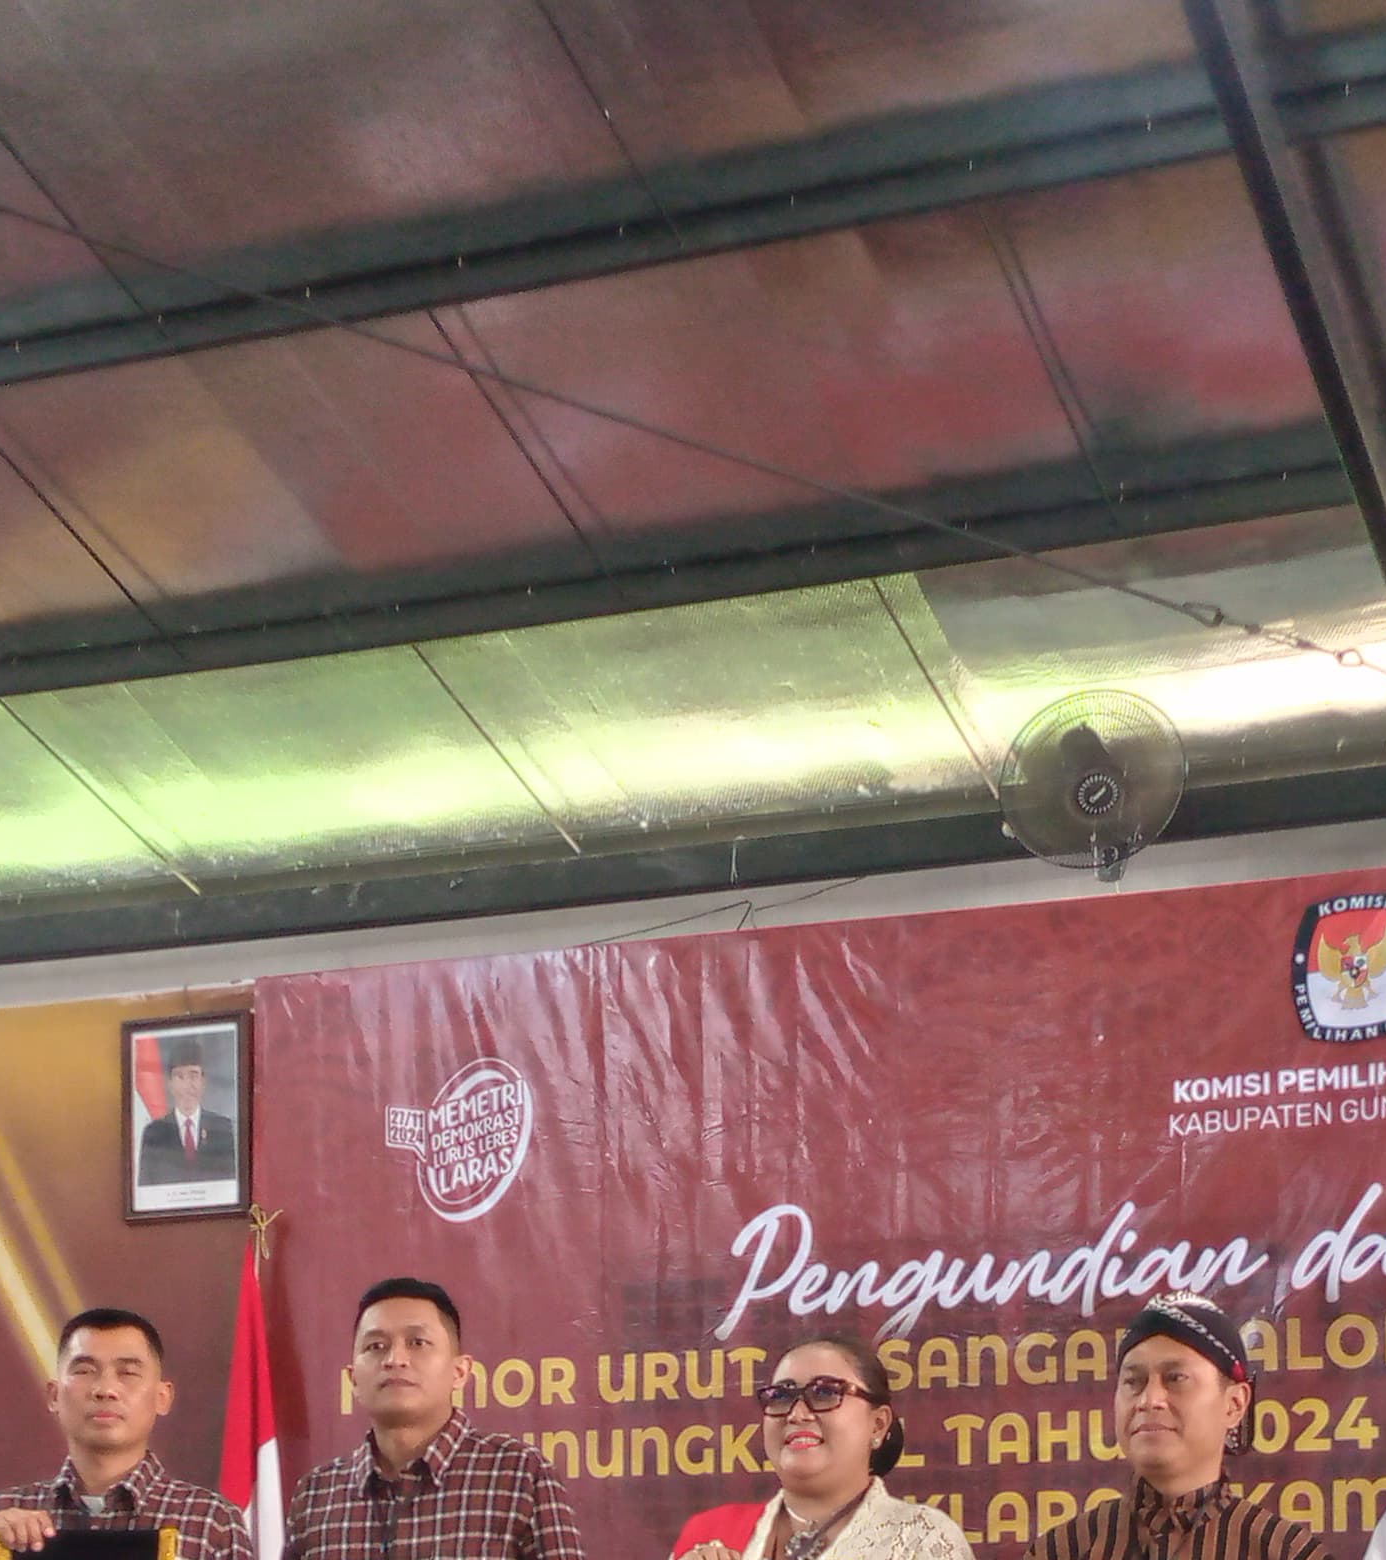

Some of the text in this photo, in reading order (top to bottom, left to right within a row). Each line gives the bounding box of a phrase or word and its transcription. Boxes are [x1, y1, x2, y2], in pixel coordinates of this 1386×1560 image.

[1295, 984, 1378, 1041] PEMILIHAN
[428, 1080, 523, 1133] MEMETRI
[1173, 1072, 1270, 1104] KOMISI
[390, 1126, 424, 1145] 2024
[391, 1110, 423, 1128] 27/11
[431, 1106, 520, 1151] DEMOKRASI
[1169, 1102, 1332, 1138] KABUPATEN
[433, 1127, 518, 1169] LURUS LERES
[439, 1147, 512, 1194] LARAS
[714, 1202, 1267, 1342] Pengundian
[598, 1346, 767, 1401] URUT
[944, 1409, 1127, 1466] TAHU
[1253, 1393, 1379, 1454] 024
